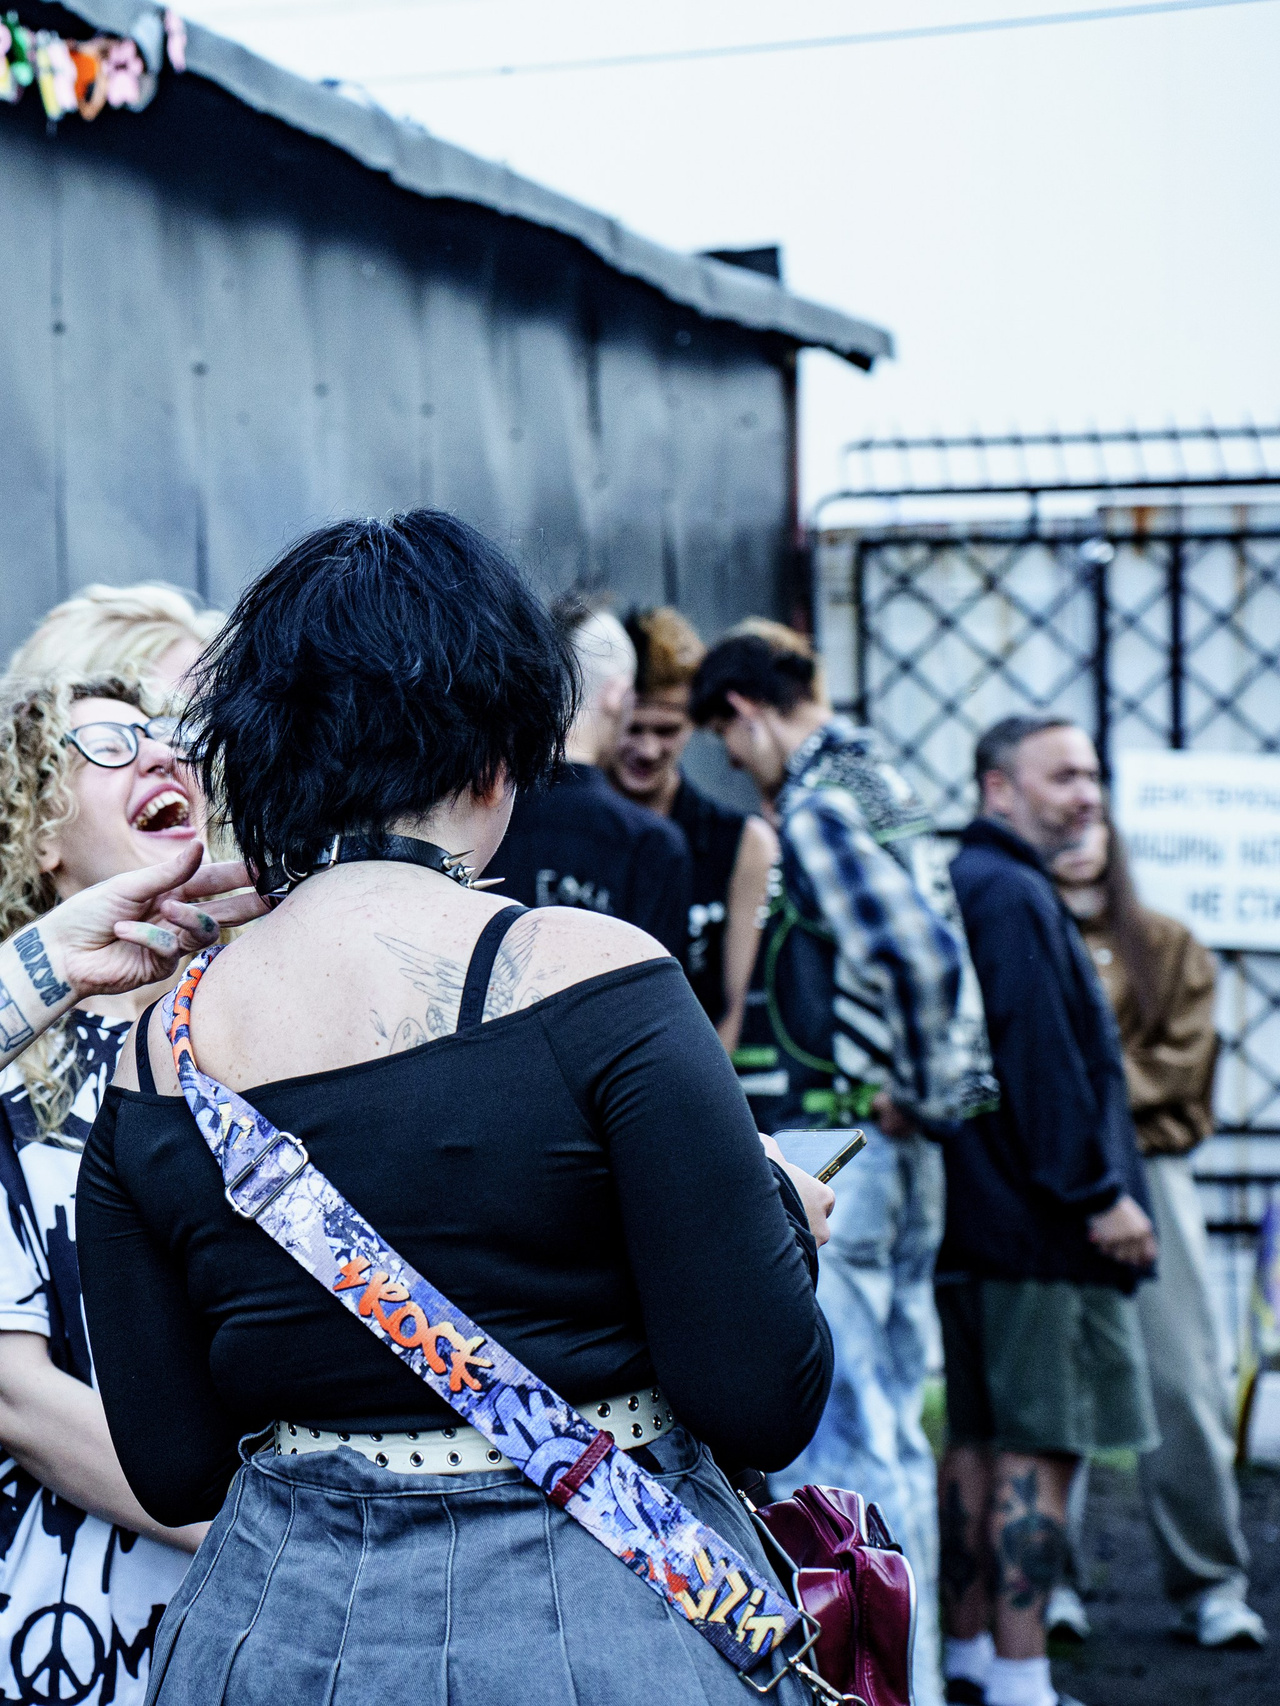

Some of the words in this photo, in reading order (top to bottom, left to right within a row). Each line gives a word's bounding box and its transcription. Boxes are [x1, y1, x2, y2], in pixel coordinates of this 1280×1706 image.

[1235, 888, 1280, 922] СТ
[13, 927, 71, 1007] ПОХУЙ
[357, 1271, 494, 1393] ROCK
